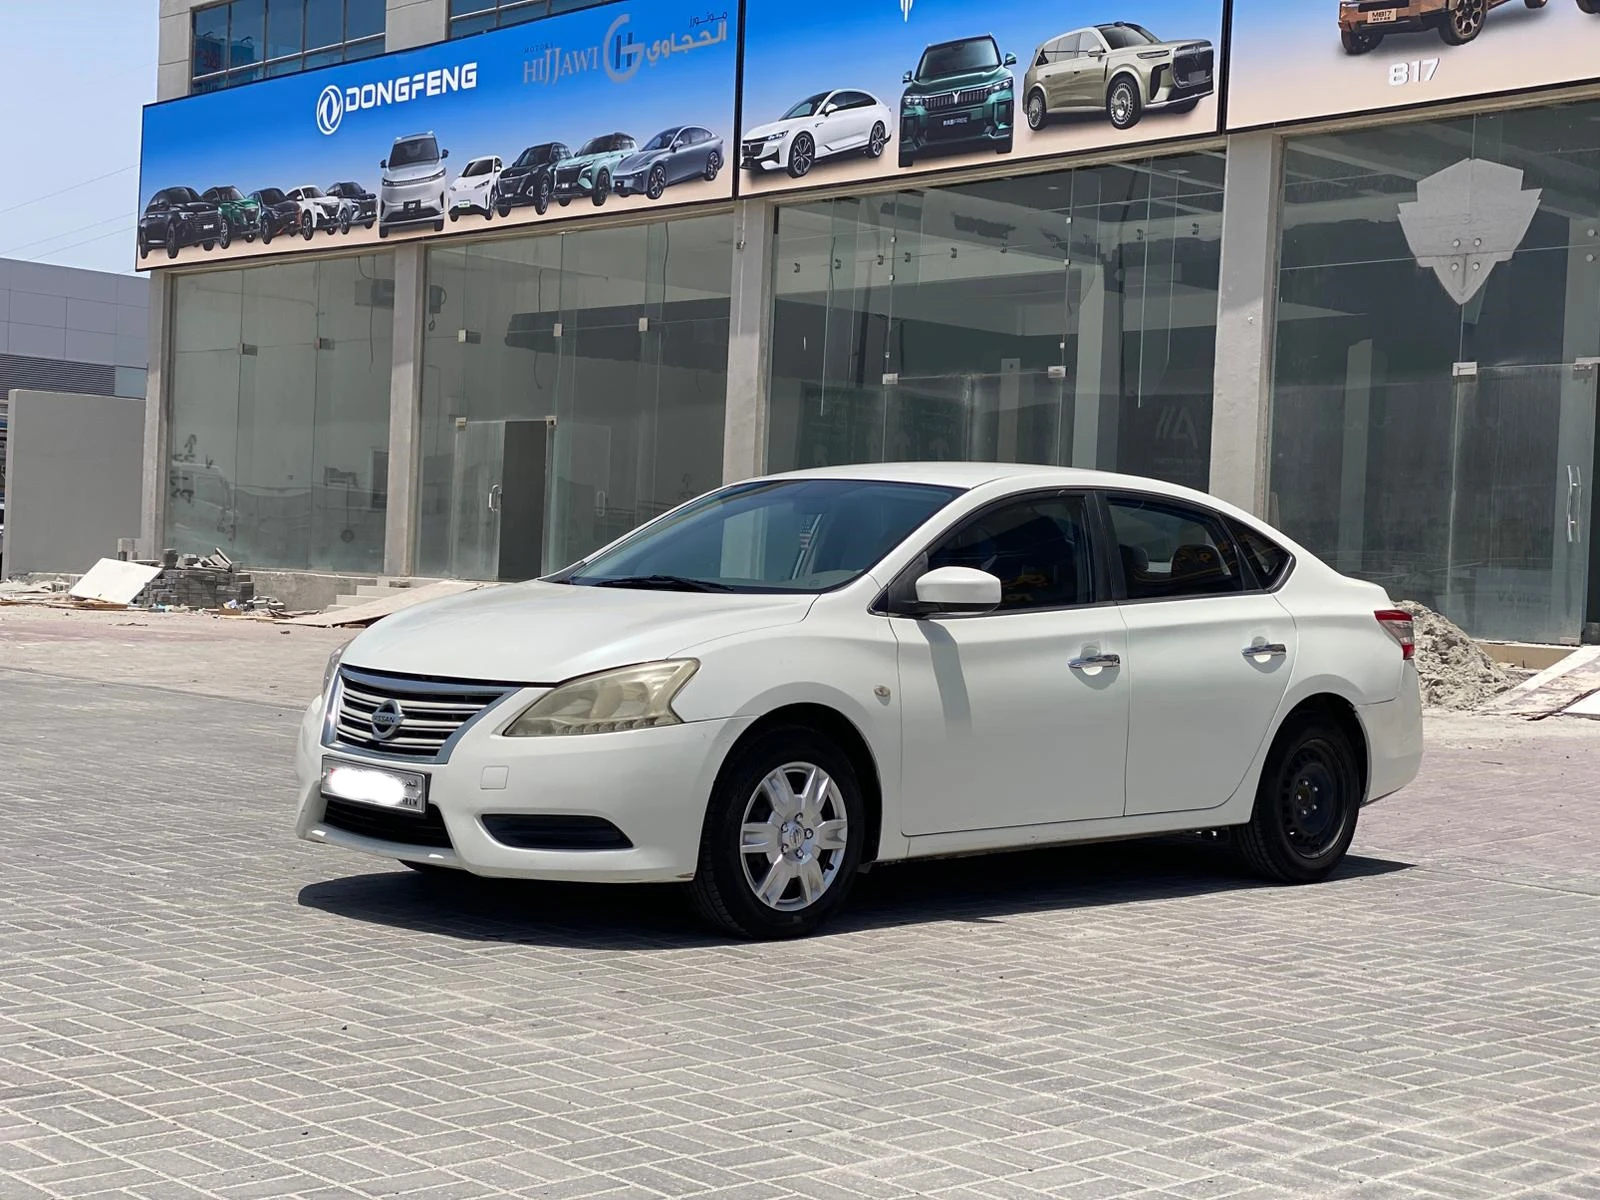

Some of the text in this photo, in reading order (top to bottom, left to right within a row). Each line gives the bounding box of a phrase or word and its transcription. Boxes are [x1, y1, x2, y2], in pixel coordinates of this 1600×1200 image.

[1371, 10, 1392, 18] M817
[646, 20, 727, 66] الحجاوي
[523, 47, 599, 86] HIJJAWI
[1389, 58, 1441, 86] 817
[345, 62, 478, 112] DONGFENG
[373, 714, 395, 723] NISSAN
